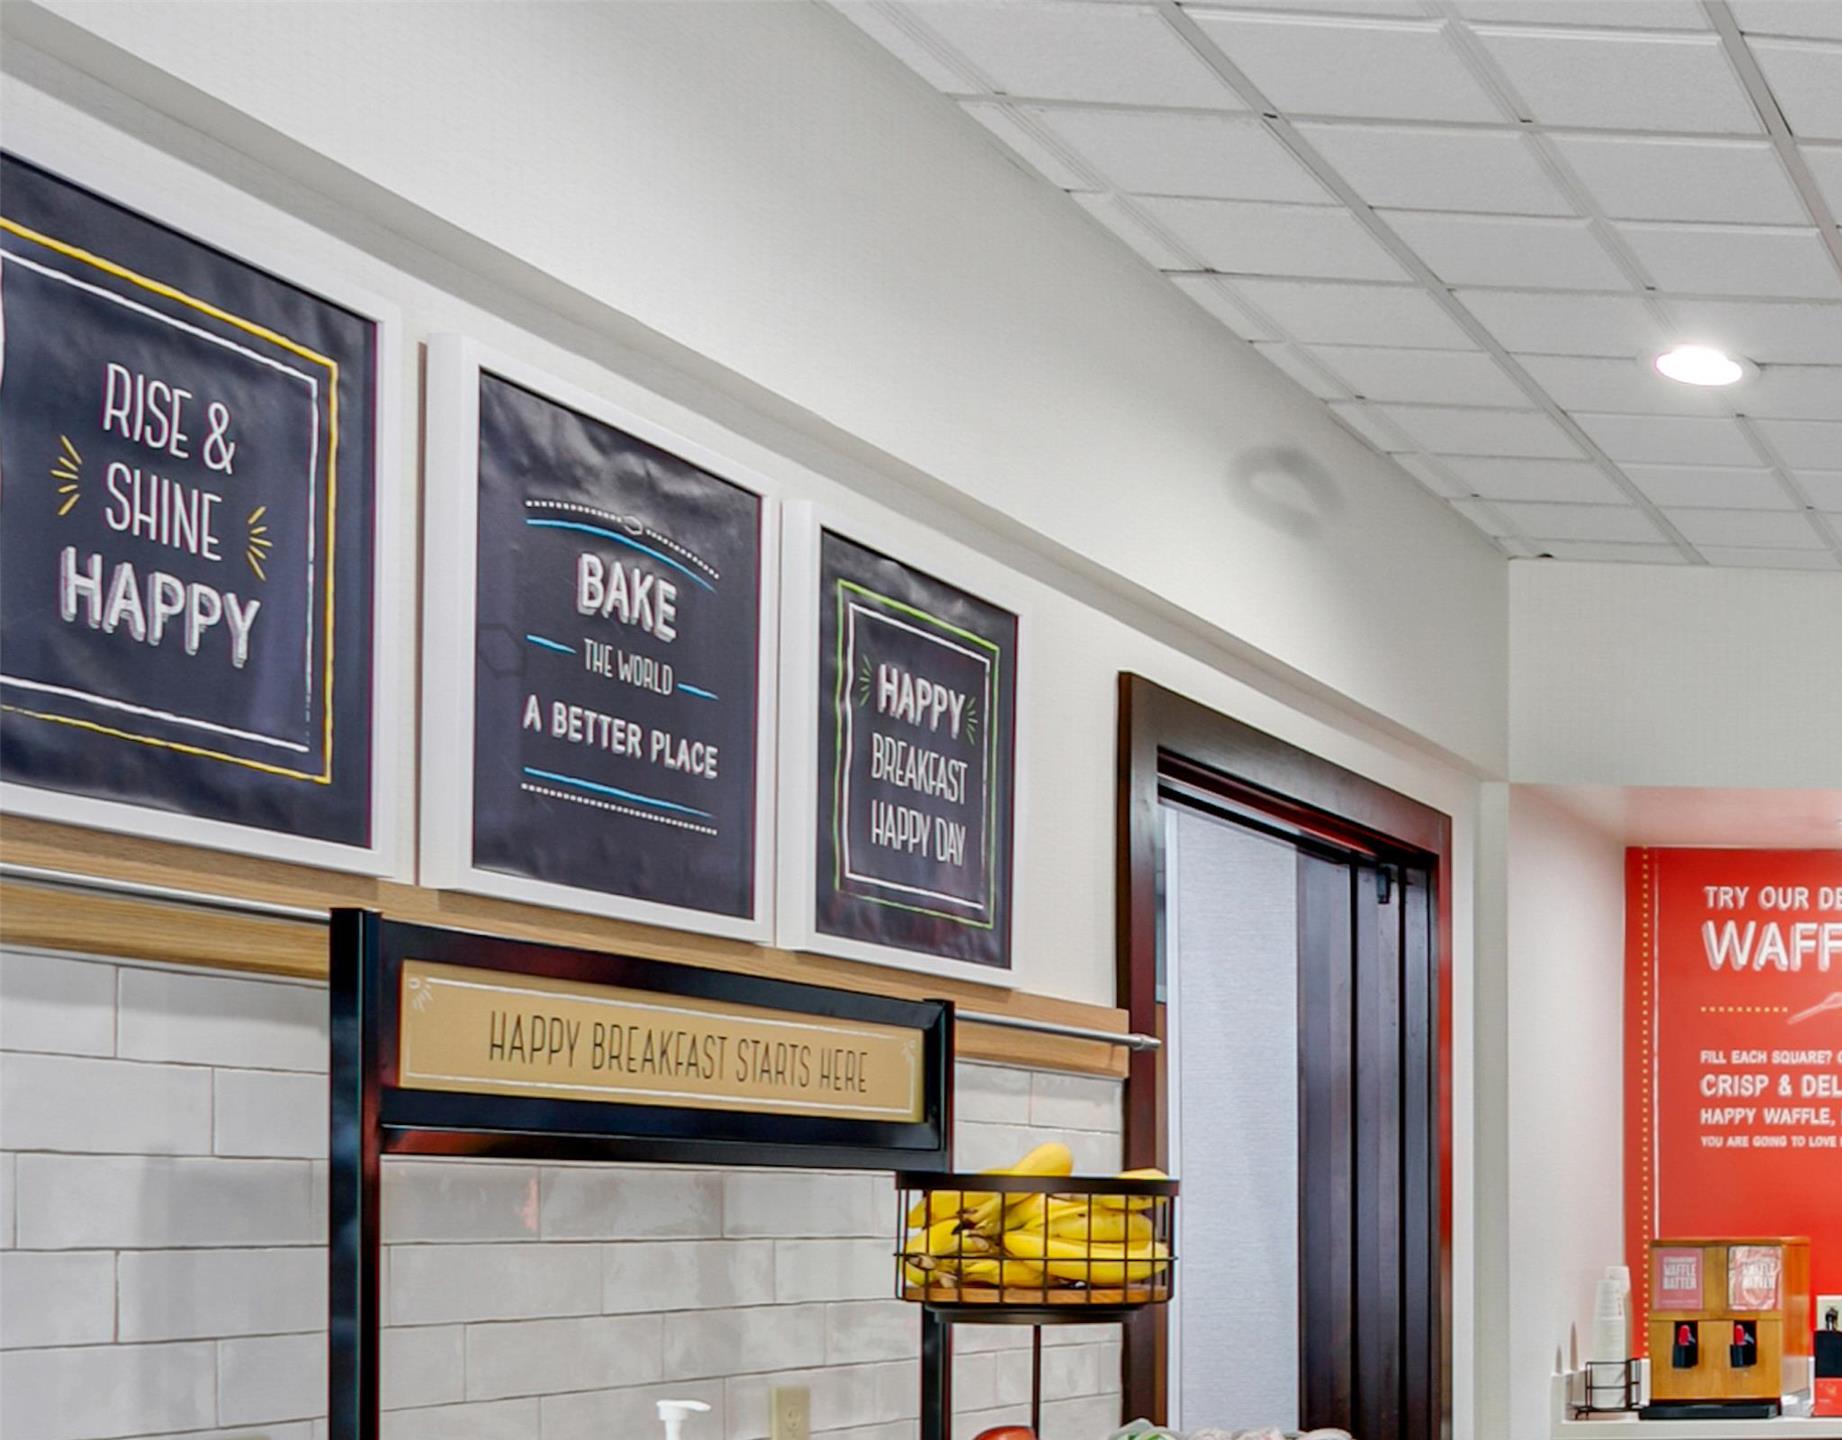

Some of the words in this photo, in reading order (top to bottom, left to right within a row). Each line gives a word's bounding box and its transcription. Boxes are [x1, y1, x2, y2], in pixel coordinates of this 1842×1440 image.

[104, 363, 192, 458] RISE
[203, 402, 235, 474] &
[105, 462, 222, 561] SHINE
[60, 546, 260, 668] HAPPY
[577, 553, 677, 643] BAKE
[584, 638, 613, 678] THE
[617, 649, 673, 695] WORLD
[877, 664, 965, 739] HAPPY
[523, 694, 542, 732] A
[552, 701, 642, 758] BETTER
[651, 729, 718, 779] PLACE
[871, 732, 968, 804] BREAKFAST
[871, 799, 931, 857] HAPPY
[934, 817, 966, 866] DAY
[1704, 886, 1750, 910] TRY
[1759, 886, 1809, 910] OUR
[489, 1010, 581, 1067] HAPPY
[591, 1021, 728, 1081] BREAKFAST
[736, 1037, 811, 1089] STARTS
[819, 1047, 868, 1093] HERE
[1700, 1050, 1726, 1064] FILL
[1731, 1050, 1767, 1064] EACH
[1771, 1050, 1832, 1065] SQUARE?
[1700, 1074, 1769, 1097] CRISP
[1778, 1074, 1792, 1097] &
[1700, 1108, 1757, 1125] HAPPY
[1763, 1108, 1836, 1127] WAFFLE,
[1700, 1135, 1723, 1147] YOU
[1726, 1135, 1749, 1147] ARE
[1753, 1135, 1787, 1147] GOING
[1791, 1135, 1806, 1147] TO
[1809, 1136, 1837, 1147] LOVE
